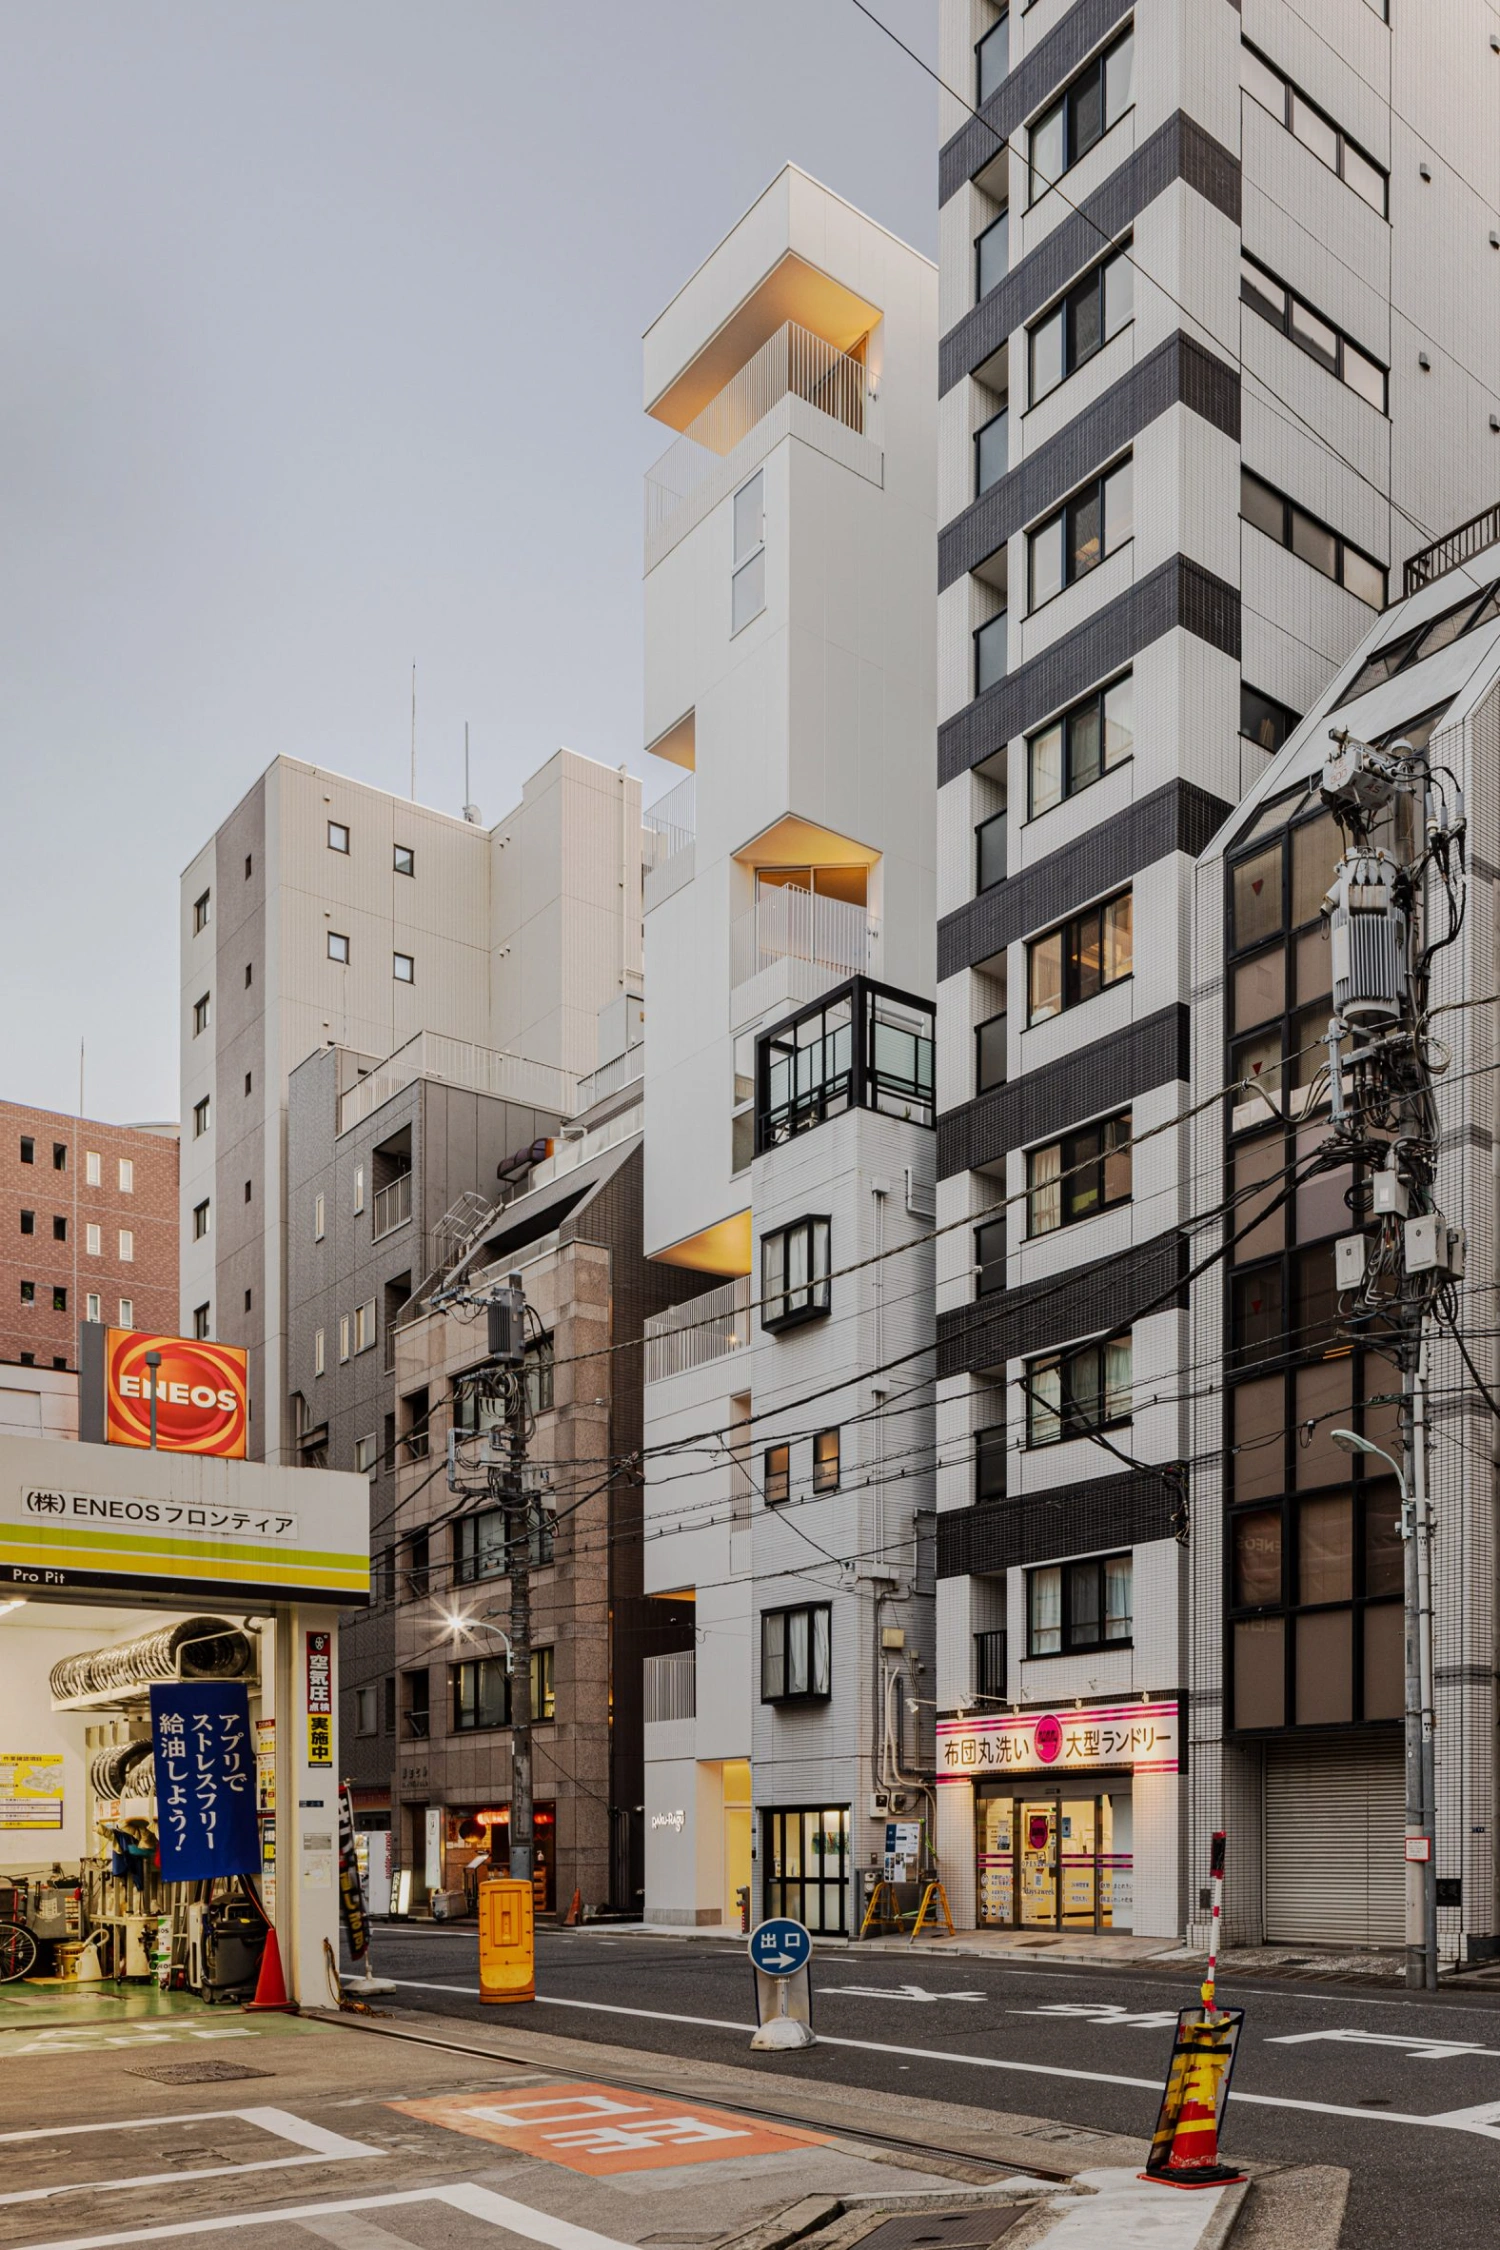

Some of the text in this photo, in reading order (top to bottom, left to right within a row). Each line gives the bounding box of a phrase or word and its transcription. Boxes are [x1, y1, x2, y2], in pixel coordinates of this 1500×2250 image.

[119, 1374, 238, 1412] ENEOS
[13, 1568, 65, 1585] Pro Pit
[219, 1713, 248, 1792] アプリで
[311, 1716, 329, 1760] 実施中
[944, 1739, 1029, 1767] 布団丸洗い
[1066, 1726, 1172, 1759] 大型ランドリー
[159, 1712, 189, 1852] 給油しよう!
[192, 1714, 218, 1850] ストレスフリー
[760, 1932, 801, 1949] 出口
